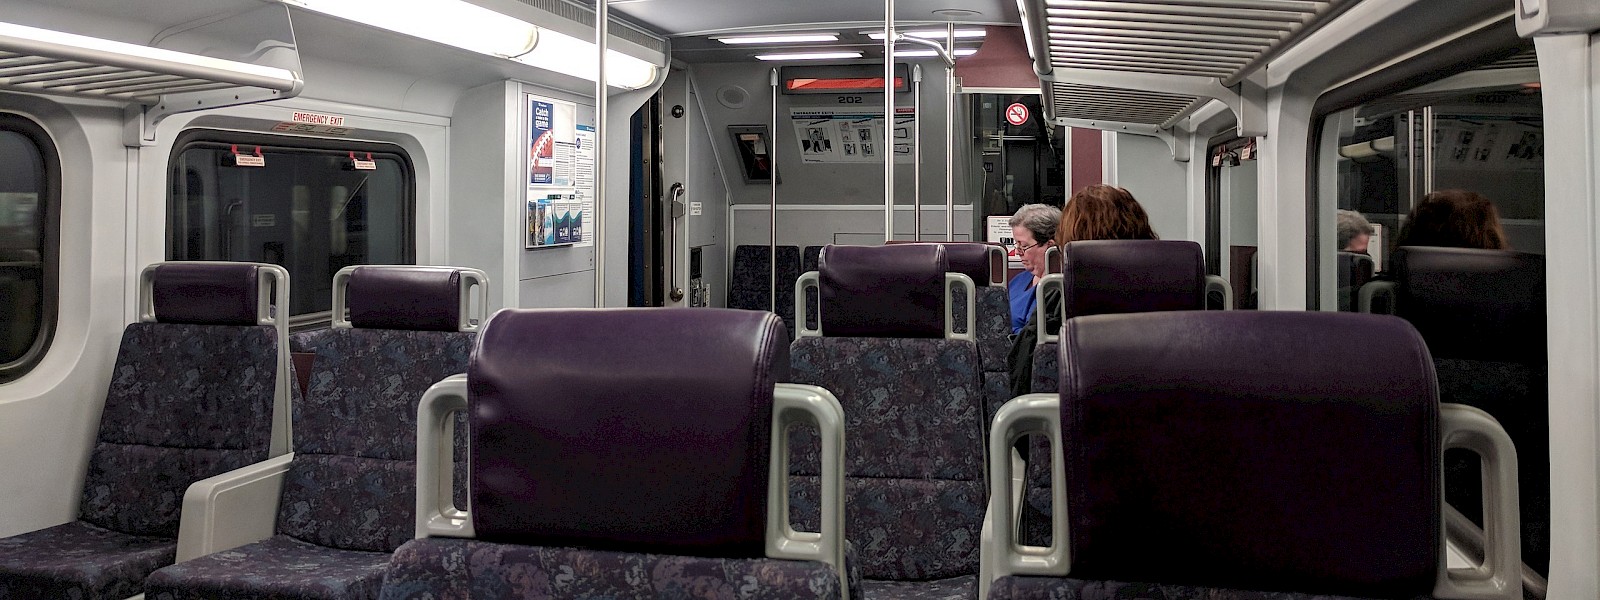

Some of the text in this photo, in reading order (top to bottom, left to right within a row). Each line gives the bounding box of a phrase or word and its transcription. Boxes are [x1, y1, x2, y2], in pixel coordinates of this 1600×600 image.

[535, 107, 549, 117] Catch
[293, 112, 343, 126] EMERGENCY EXIT
[535, 120, 549, 129] game
